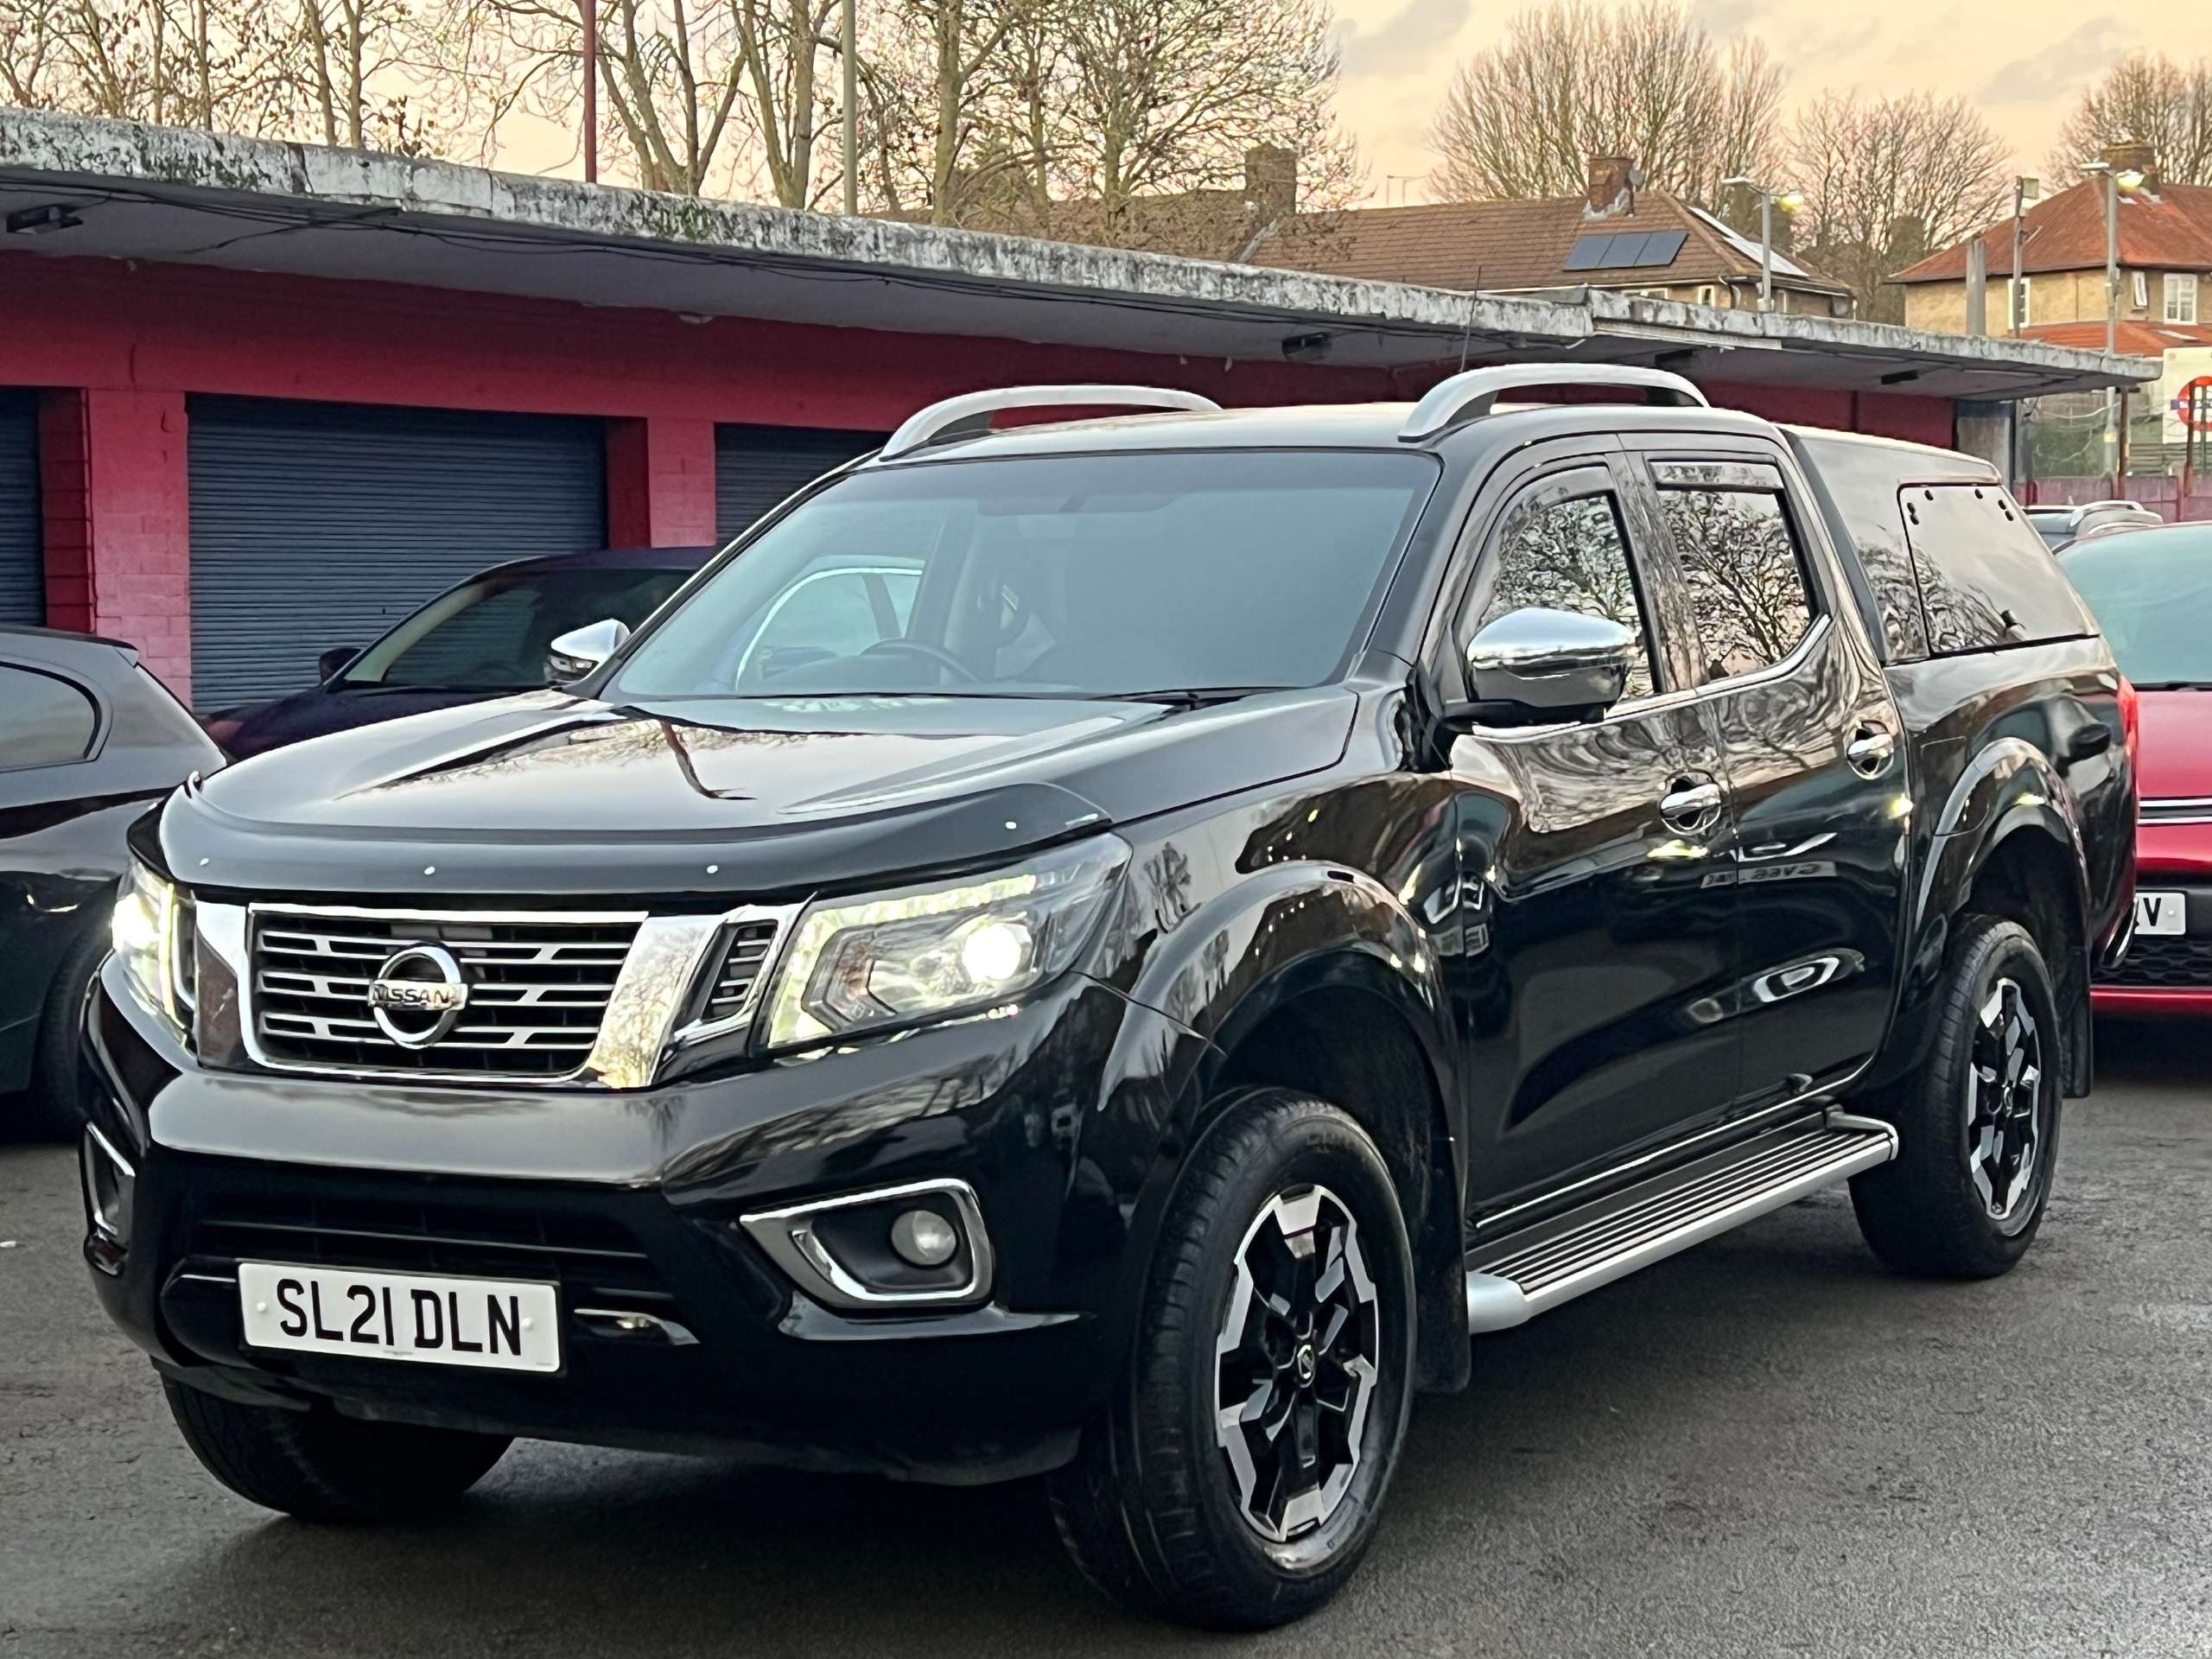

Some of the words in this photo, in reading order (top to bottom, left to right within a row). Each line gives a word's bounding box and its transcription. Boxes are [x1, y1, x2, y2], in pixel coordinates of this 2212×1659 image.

[373, 986, 450, 1003] NISSAN
[276, 1278, 395, 1345] SL21
[410, 1288, 522, 1356] DLN
